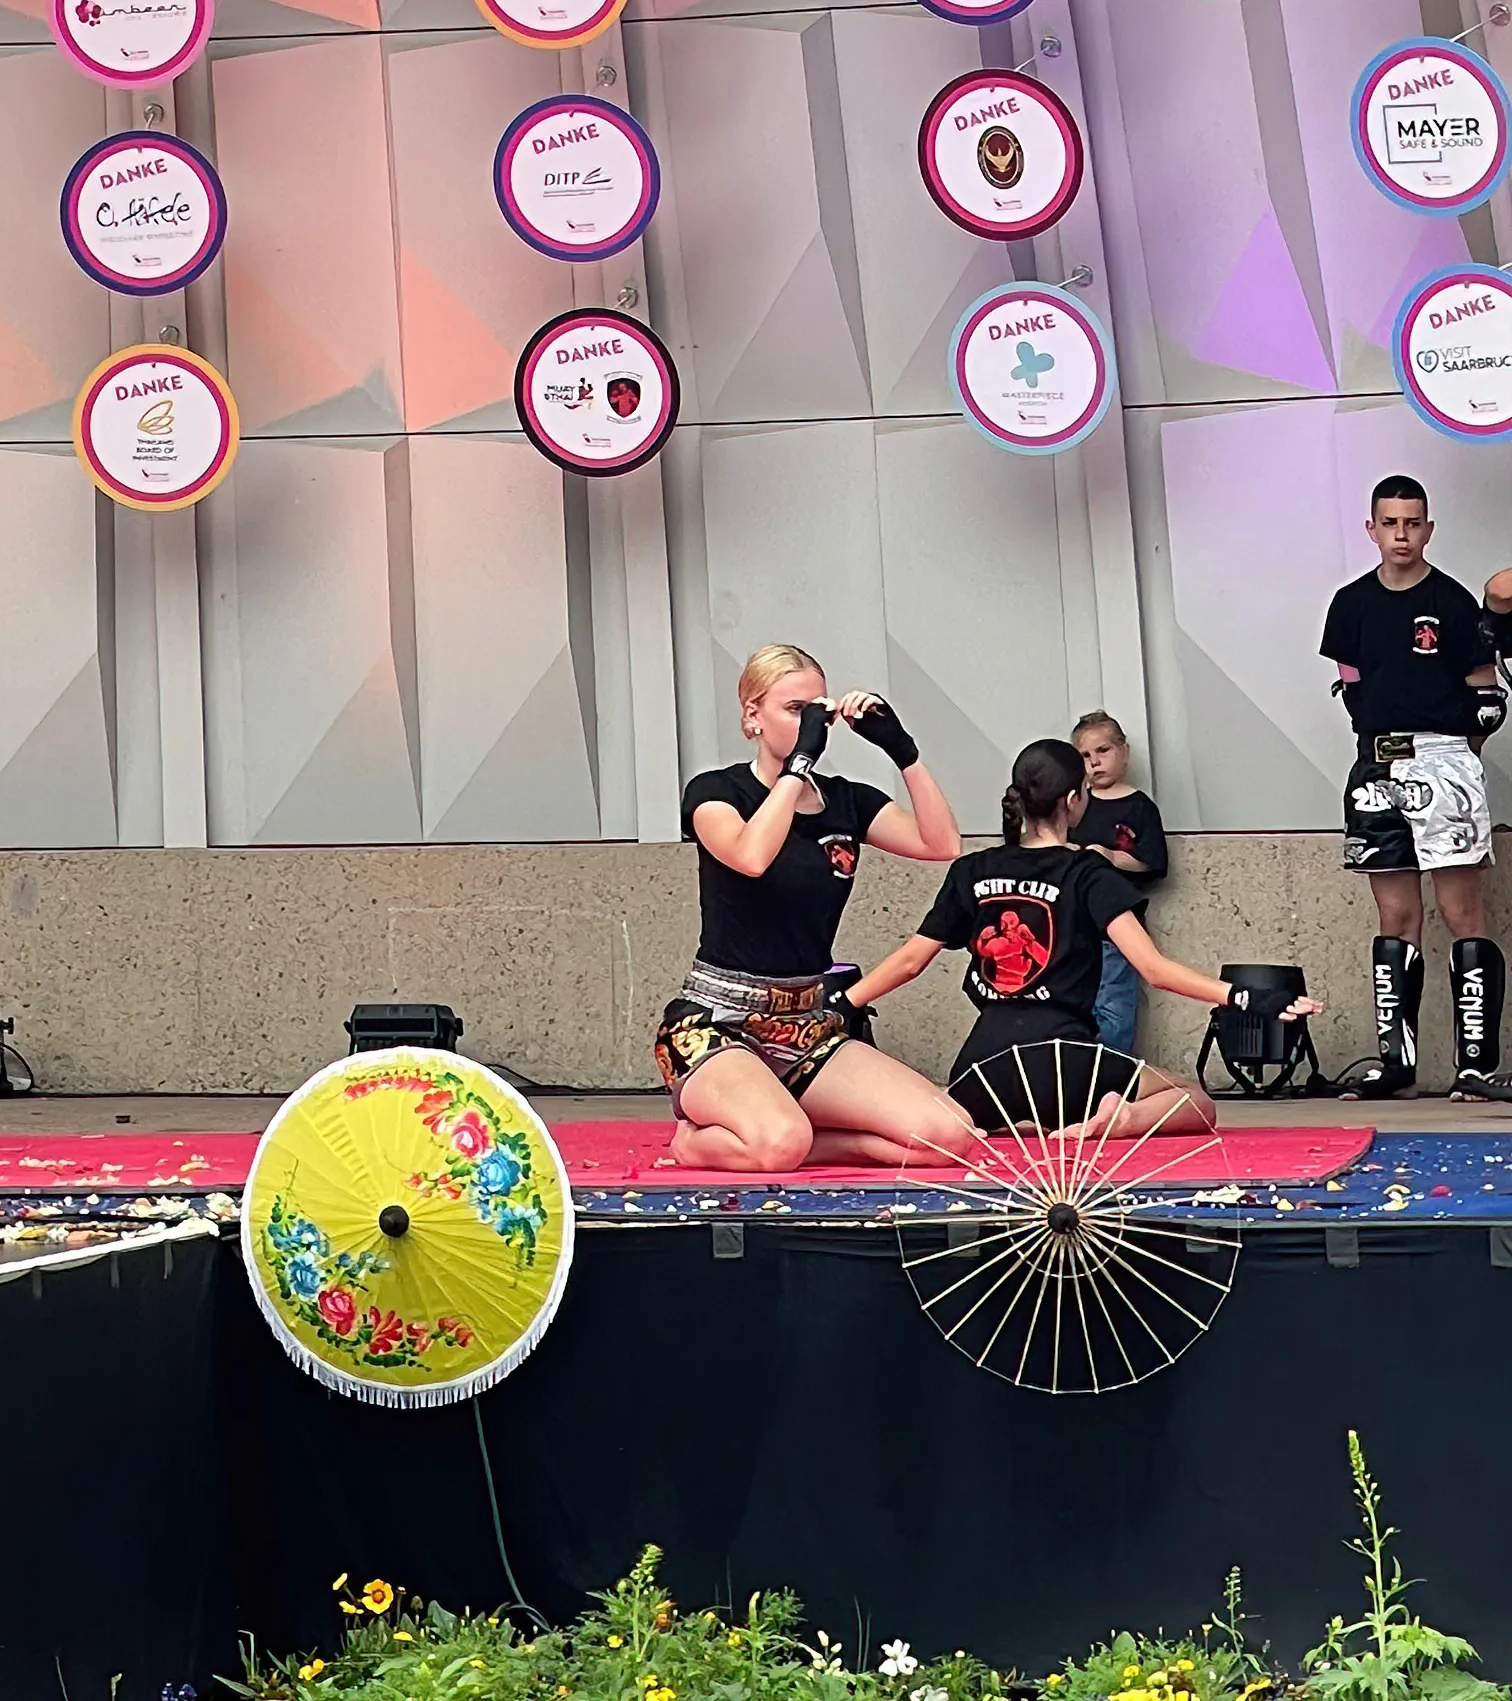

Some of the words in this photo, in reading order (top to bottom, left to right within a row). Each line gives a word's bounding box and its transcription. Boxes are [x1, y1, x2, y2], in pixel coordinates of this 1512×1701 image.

[1388, 68, 1454, 101] DANKE
[953, 97, 1021, 131] DANKE
[1397, 117, 1481, 138] MAYER
[531, 123, 600, 154] DANKE
[1399, 138, 1427, 149] SAFE
[1431, 138, 1438, 148] &
[1441, 137, 1483, 148] SOUND
[99, 158, 168, 189] DANKE
[544, 171, 580, 186] DITP
[1429, 294, 1496, 330] DANKE
[988, 313, 1056, 341] DANKE
[556, 339, 624, 365] DANKE
[1439, 345, 1472, 360] VISIT
[115, 375, 183, 401] DANKE
[1376, 964, 1400, 1036] VENUM
[1458, 968, 1484, 1040] VENUM
